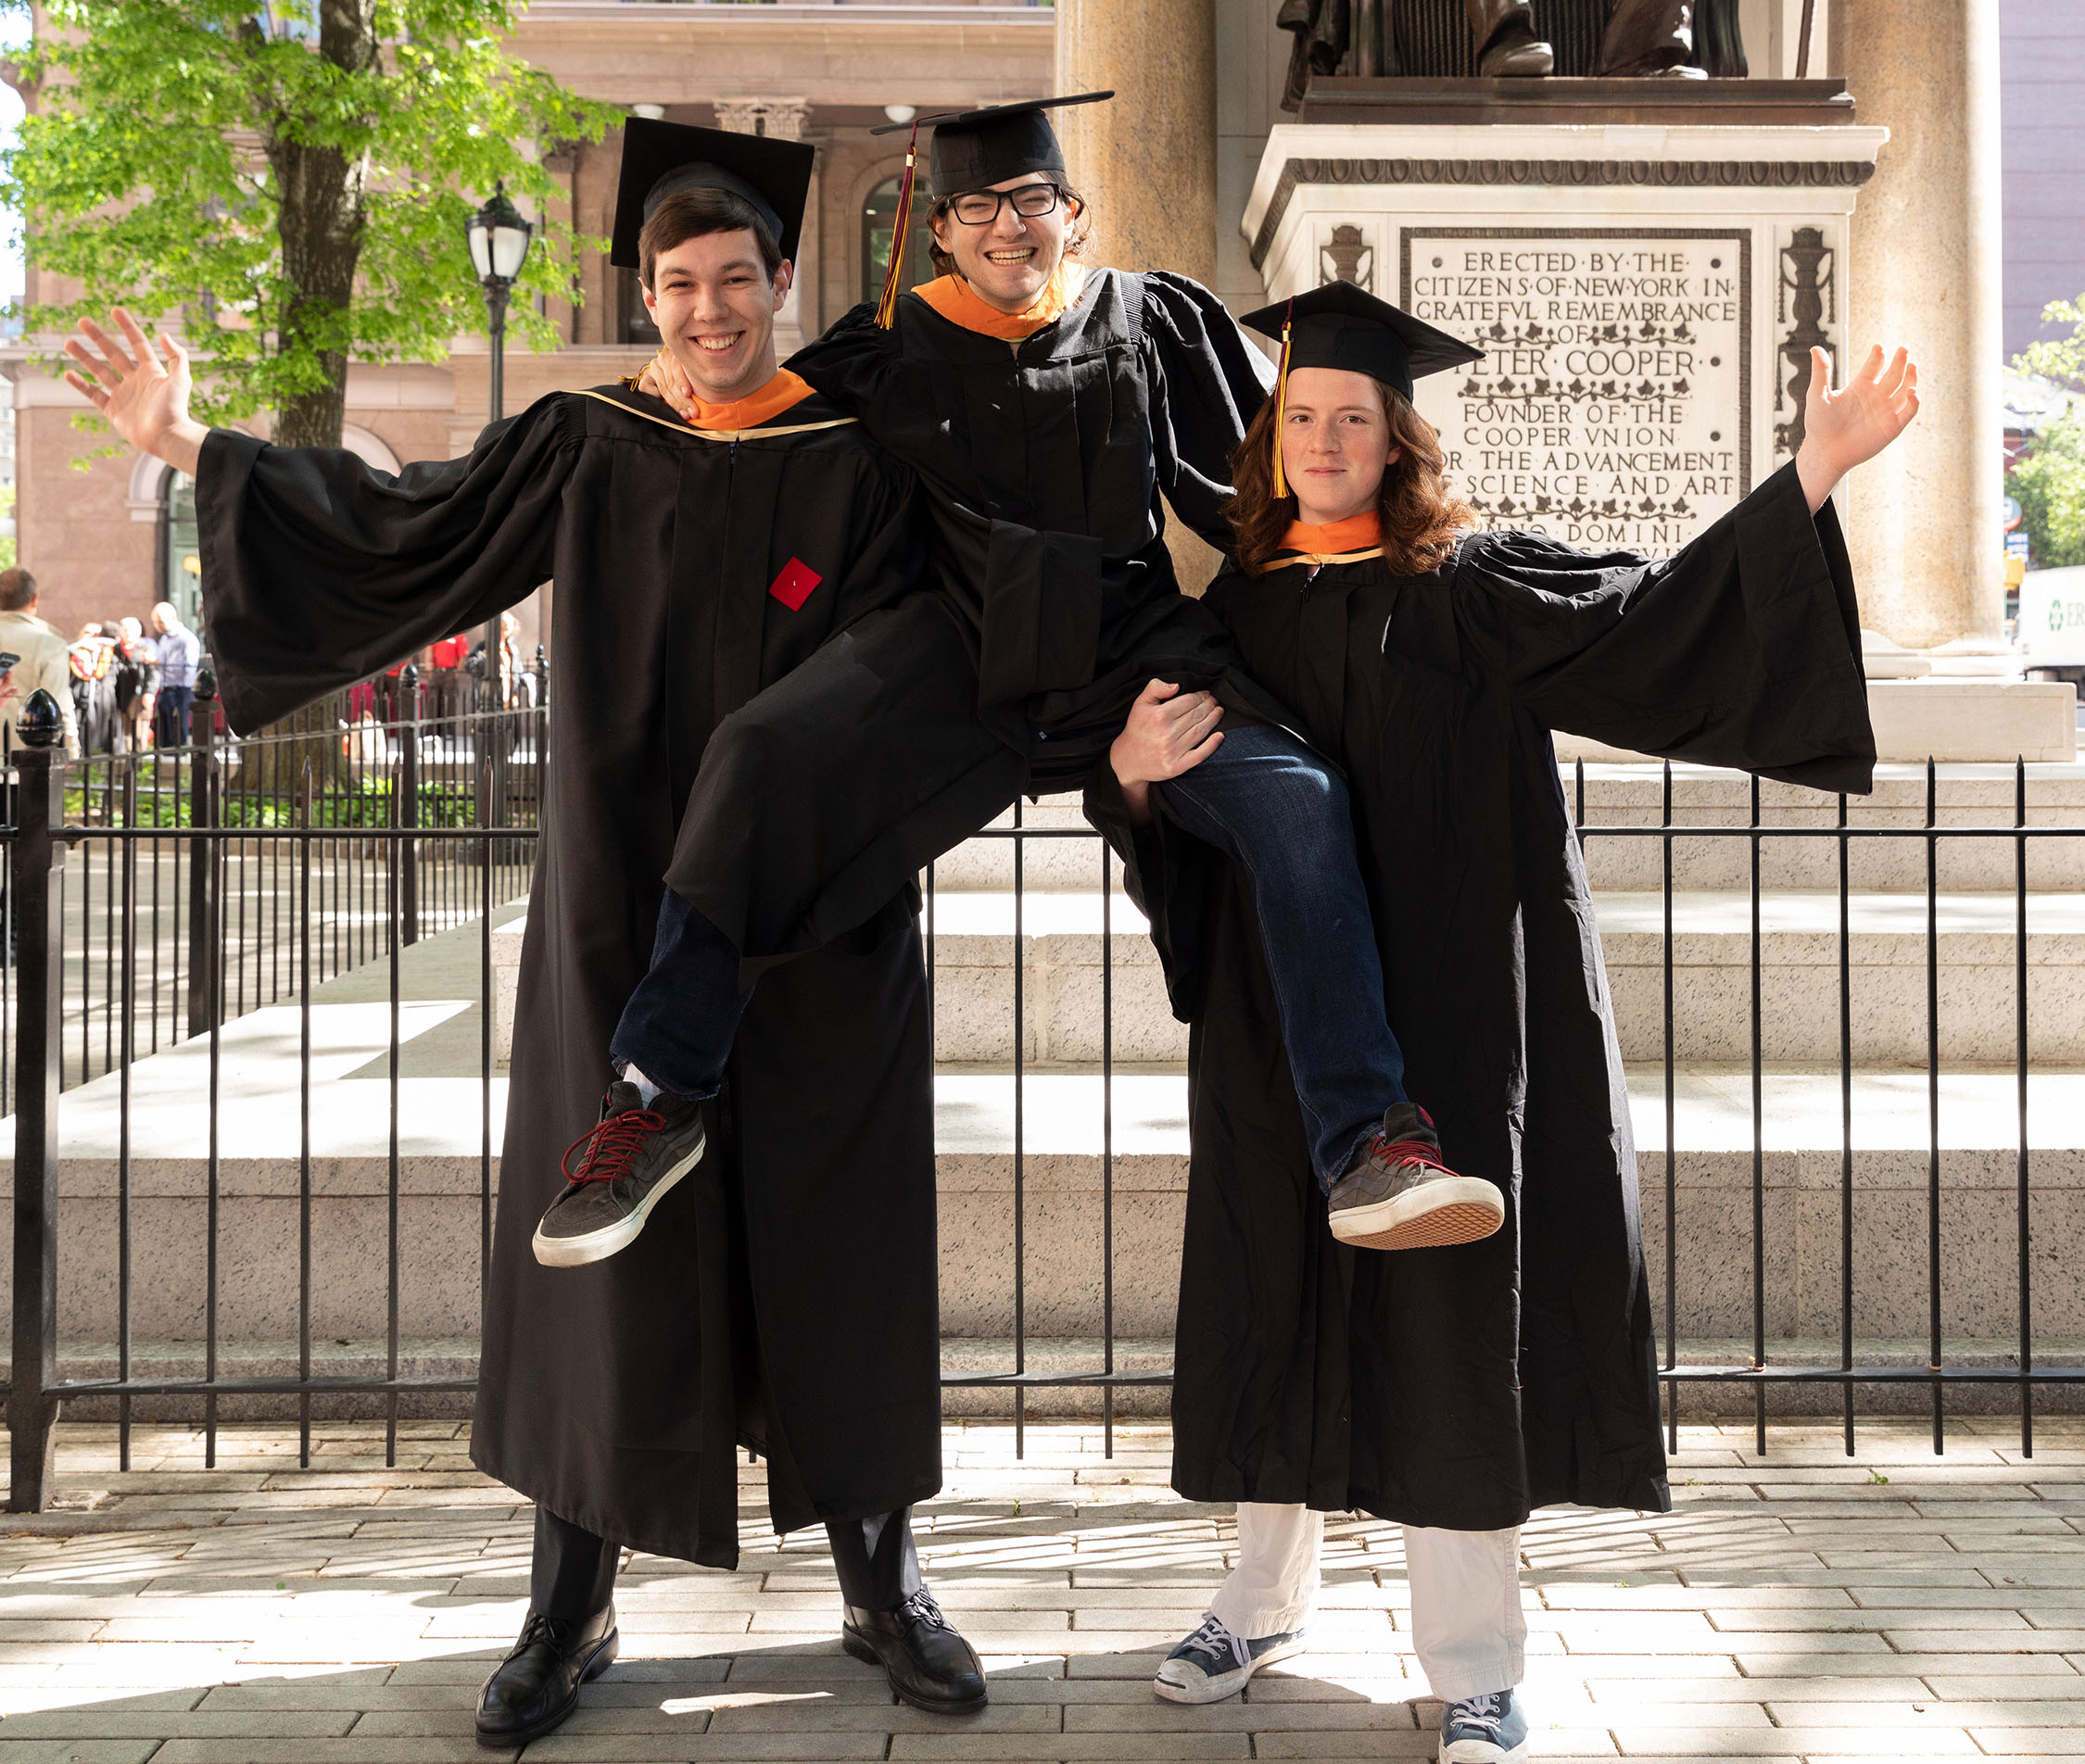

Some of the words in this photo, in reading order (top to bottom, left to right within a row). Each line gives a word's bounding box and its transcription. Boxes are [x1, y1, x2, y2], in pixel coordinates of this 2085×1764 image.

[1464, 252, 1576, 271] ERECTED
[1590, 253, 1624, 272] BY
[1633, 253, 1684, 272] THE
[1414, 277, 1528, 296] CITIZENS
[1535, 277, 1567, 296] OF
[1574, 278, 1624, 296] NEW
[1629, 278, 1689, 297] YORK
[1703, 278, 1729, 296] IN
[1548, 301, 1736, 321] REMEMBRANCE
[1558, 325, 1588, 344] OF
[1454, 349, 1548, 375] ETER
[1566, 349, 1695, 376] COOPER
[1464, 404, 1573, 423] FOVNDER
[1586, 405, 1621, 423] OF
[1630, 404, 1682, 423] THE
[1464, 427, 1573, 447] COOPER
[1585, 428, 1674, 447] VNION
[1480, 451, 1532, 471] THE
[1543, 451, 1734, 472] ADVANCEMENT
[1466, 474, 1588, 495] SCIENCE
[1610, 474, 1670, 495] AND
[1683, 475, 1734, 495] ART
[1568, 523, 1681, 543] DOMINI
